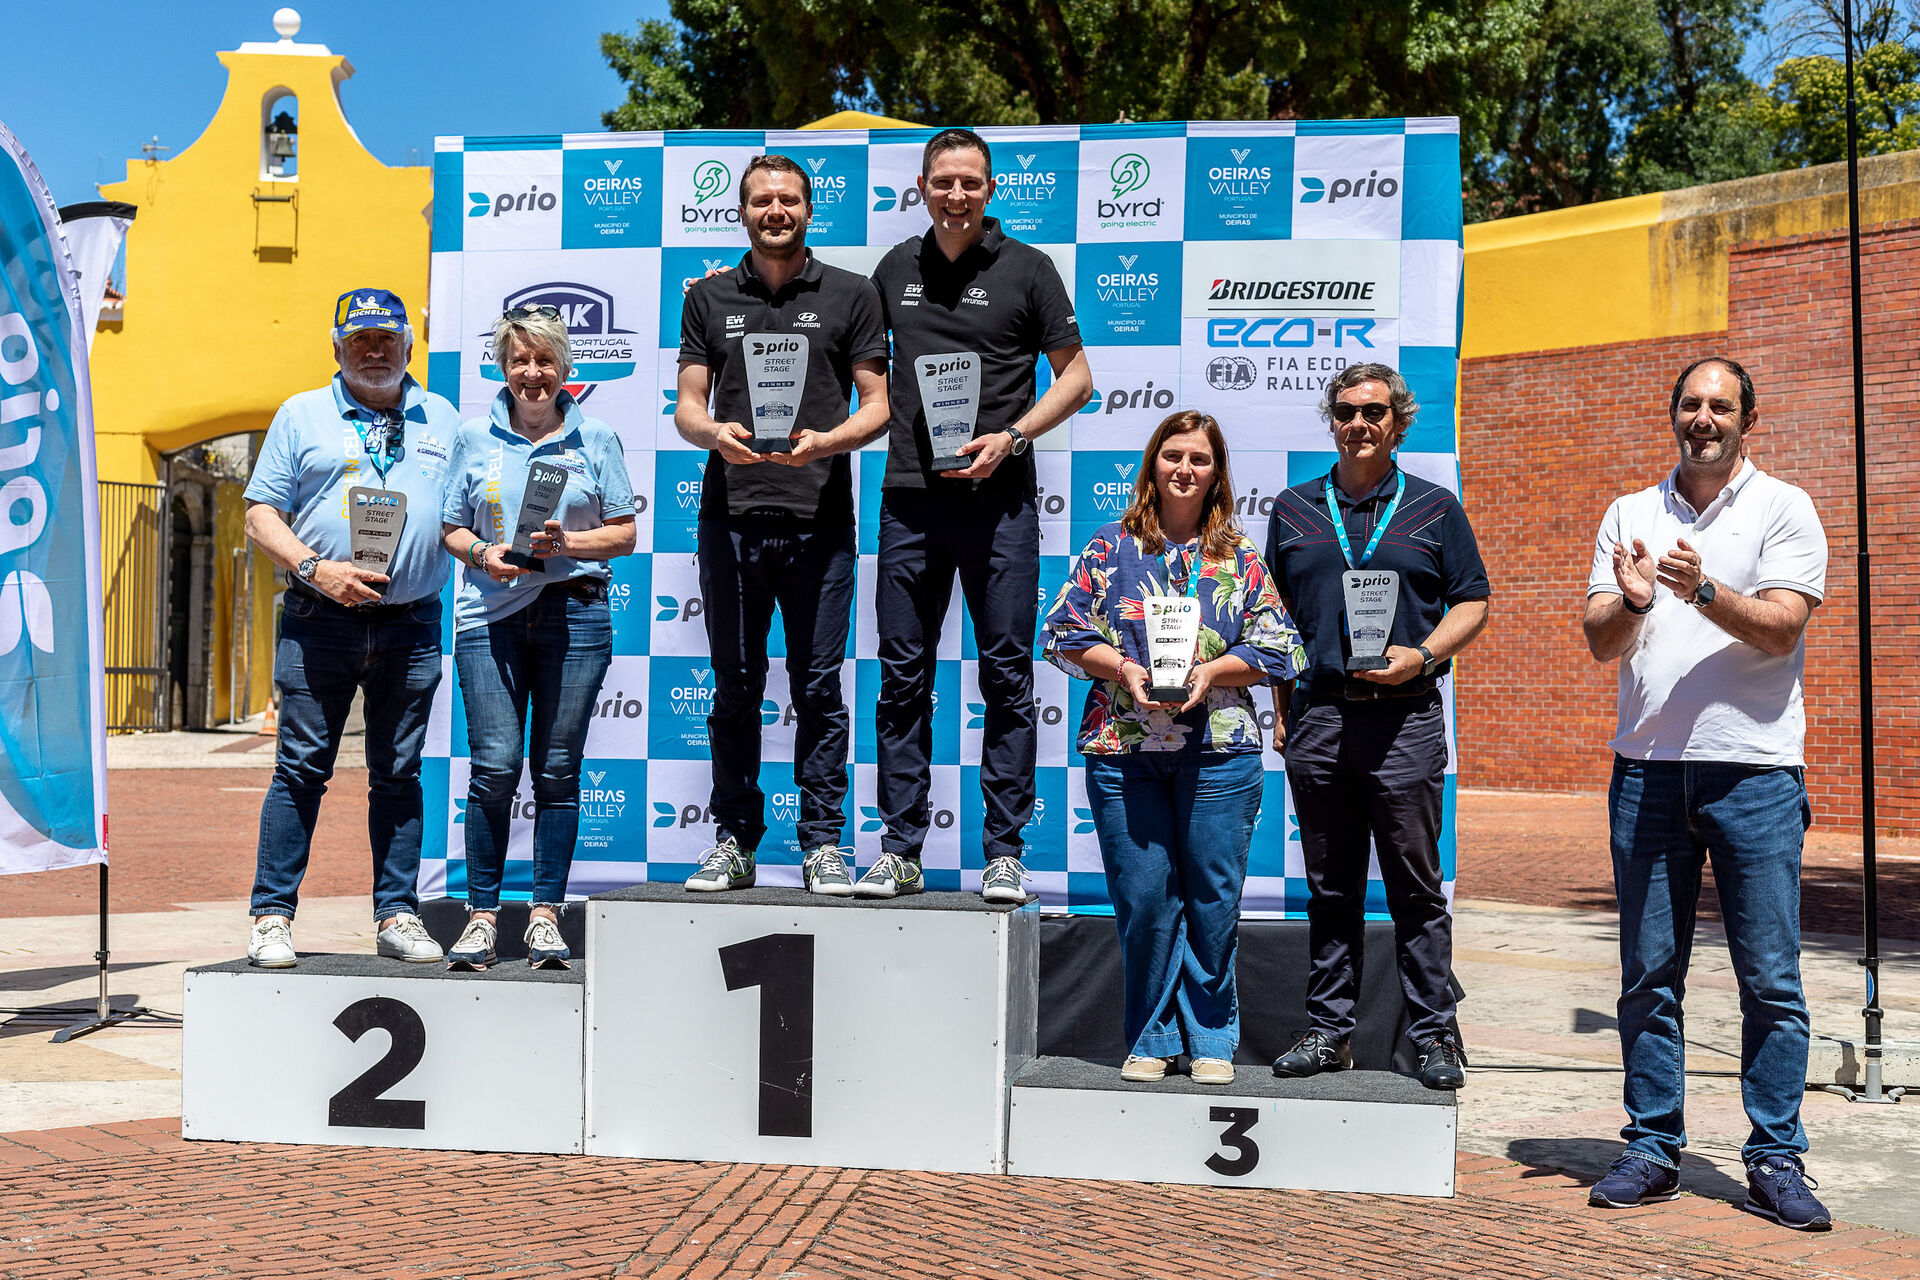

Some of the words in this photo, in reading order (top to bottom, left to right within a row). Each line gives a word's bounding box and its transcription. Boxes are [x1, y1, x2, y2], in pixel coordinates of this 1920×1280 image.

[996, 172, 1056, 186] OEIRAS
[1209, 167, 1271, 180] OEIRAS
[584, 178, 642, 191] OEIRAS
[810, 176, 846, 189] IRAS
[1208, 181, 1271, 195] VALLEY
[1328, 170, 1398, 203] prio
[494, 185, 557, 216] prio
[584, 191, 642, 205] VALLEY
[995, 186, 1056, 201] VALLEY
[682, 205, 741, 223] byrd
[1097, 198, 1160, 218] byrd
[709, 224, 739, 232] electric
[1100, 221, 1125, 229] going
[1127, 220, 1157, 228] electric
[1097, 273, 1159, 287] OEIRAS
[1096, 287, 1159, 301] VALLEY
[1208, 279, 1376, 300] BRIDGESTONE
[962, 297, 989, 306] HYUNDAI
[348, 309, 391, 319] MICHELIN
[766, 338, 799, 355] prio
[571, 349, 632, 360] ERGIAS
[939, 357, 971, 375] prio
[1267, 357, 1299, 371] FIA
[1308, 357, 1347, 371] ECO
[938, 376, 968, 385] STREET
[1267, 377, 1328, 391] RALLY
[937, 384, 963, 392] STAGE
[1106, 381, 1174, 414] prio
[540, 471, 562, 484] prio
[1094, 483, 1132, 495] OEIR
[1363, 574, 1390, 588] prio
[1163, 602, 1191, 615] prio
[580, 789, 626, 802] EIRAS
[579, 804, 626, 817] ALLEY
[718, 933, 814, 1137] 1
[328, 997, 426, 1128] 2
[1204, 1107, 1260, 1175] 3
